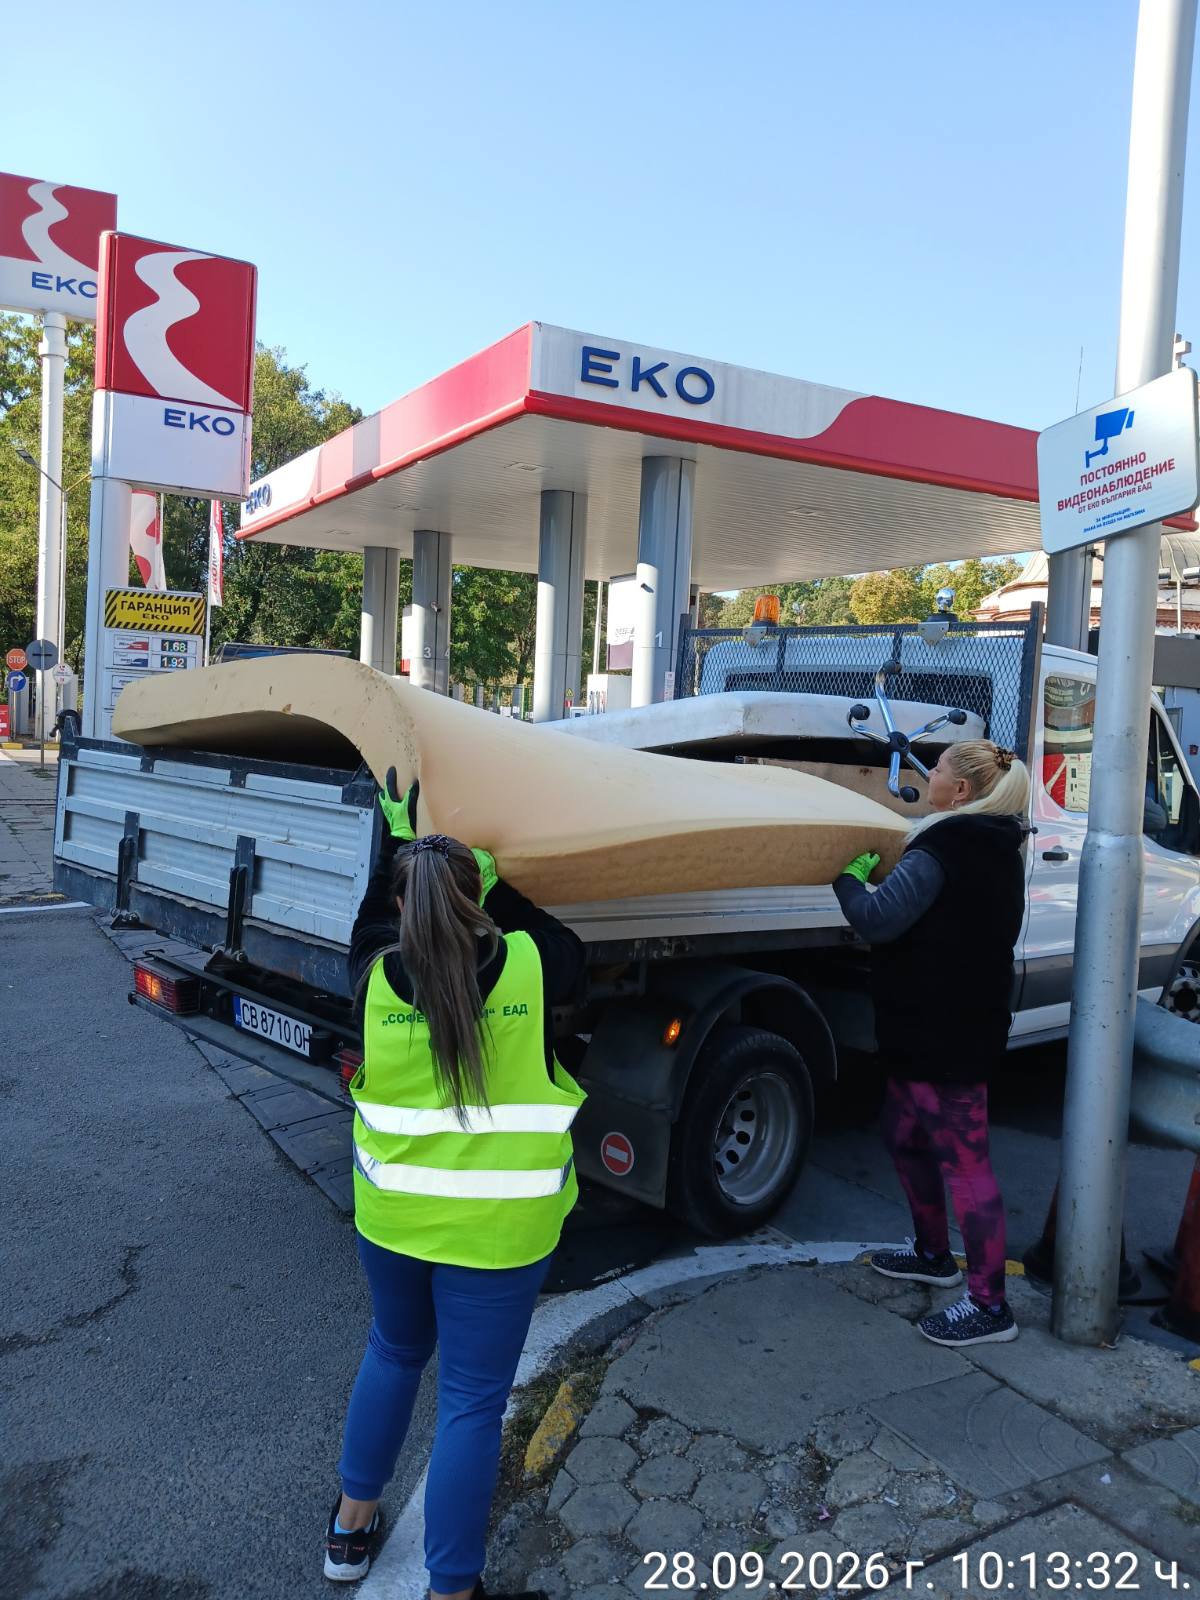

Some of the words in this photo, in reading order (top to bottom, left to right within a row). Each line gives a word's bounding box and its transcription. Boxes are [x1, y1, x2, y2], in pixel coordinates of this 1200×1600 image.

[32, 271, 98, 298] EKO
[581, 345, 715, 405] EKO
[164, 408, 235, 436] EKO
[1080, 451, 1146, 486] ПОСТОЯННО
[1057, 458, 1175, 511] ВИДЕОНАБЛЮДЕНИЕ
[1078, 504, 1086, 514] ОТ
[1101, 487, 1136, 506] БЪЛГАРИЯ
[1137, 482, 1152, 493] ЕАД
[120, 600, 190, 615] ГАРАНЦИЯ
[423, 646, 431, 659] 3
[655, 631, 663, 648] 1
[9, 655, 26, 664] STOP
[162, 656, 185, 668] 1.92
[503, 1003, 528, 1016] ЕАД
[261, 1010, 291, 1044] 8710
